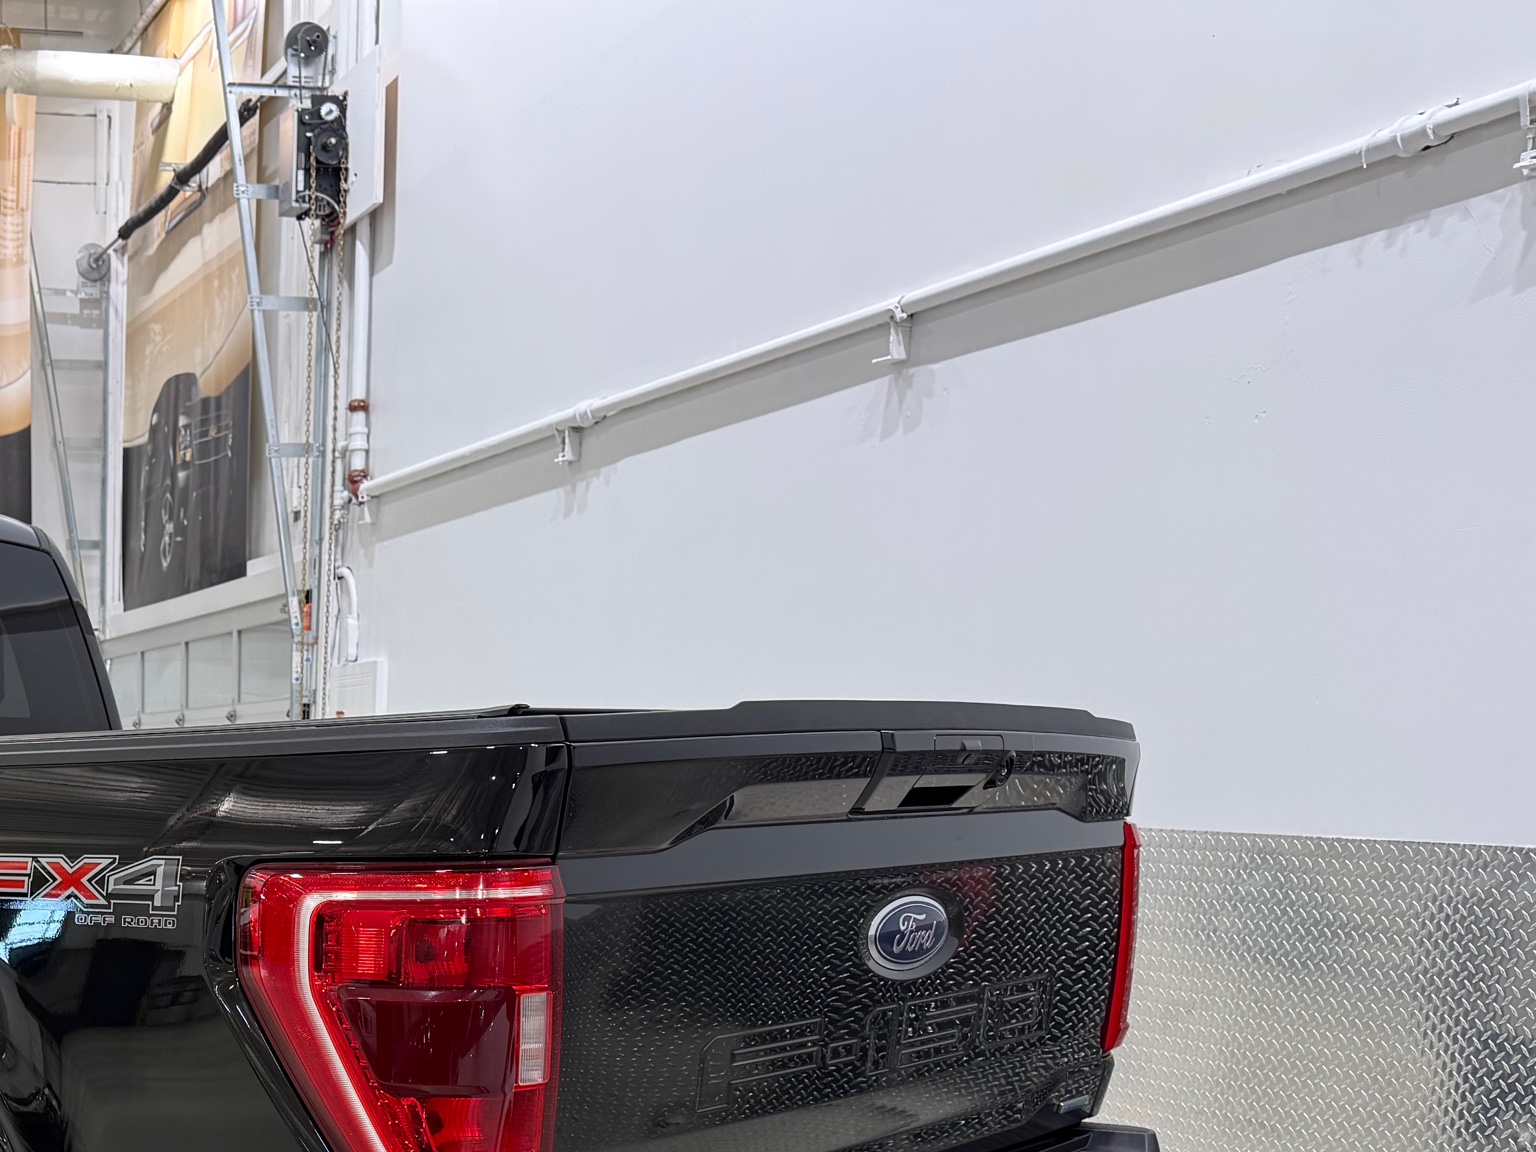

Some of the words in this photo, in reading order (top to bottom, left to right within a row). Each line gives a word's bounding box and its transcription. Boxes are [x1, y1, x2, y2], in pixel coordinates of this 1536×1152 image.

[74, 914, 116, 926] OFF
[121, 914, 177, 930] ROAD
[892, 912, 937, 954] Ford
[694, 972, 1056, 1114] F-150
